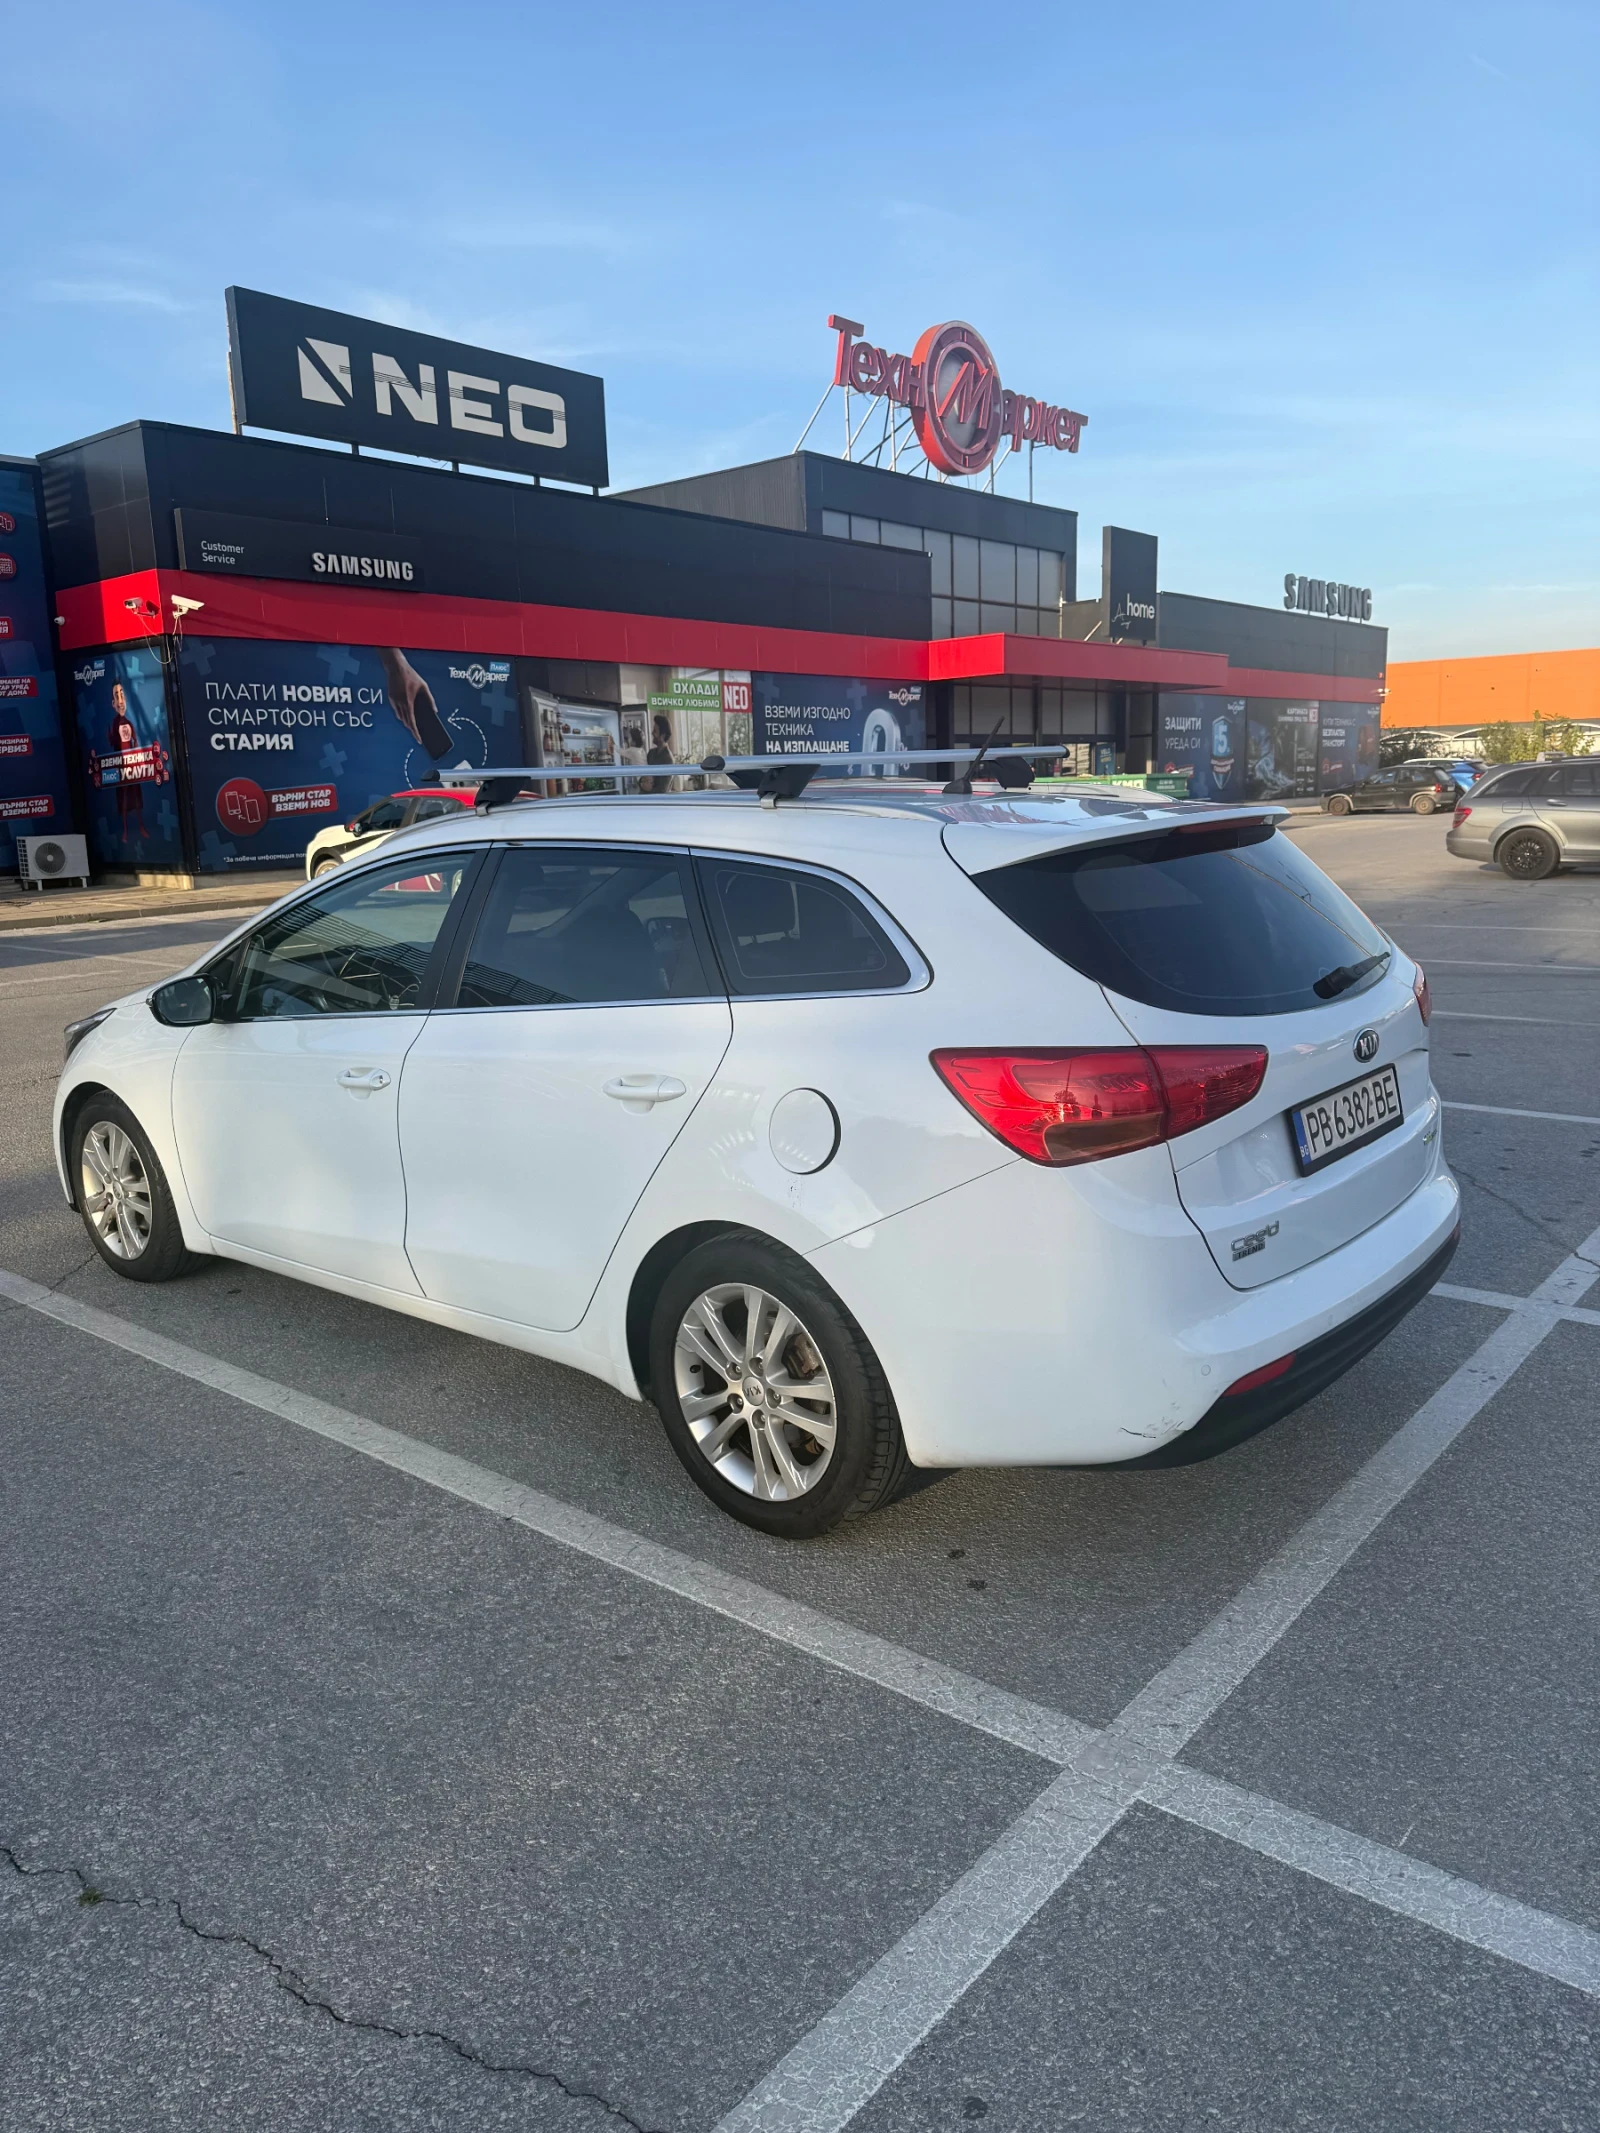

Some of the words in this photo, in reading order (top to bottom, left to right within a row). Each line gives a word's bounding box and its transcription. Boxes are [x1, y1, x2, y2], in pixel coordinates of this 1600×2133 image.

[371, 352, 567, 449] NEO
[200, 540, 244, 554] Customer
[202, 552, 236, 565] Service
[311, 552, 414, 581] SAMSUNG
[1284, 573, 1372, 621] SAMSUNG
[1126, 593, 1155, 619] home
[205, 682, 277, 700] ПЛАТИ
[283, 685, 352, 704] НОВИЯ
[357, 687, 383, 705] СИ
[673, 683, 719, 695] ОХЛАДИ
[651, 697, 683, 706] ВСИЧКО
[685, 699, 719, 708] ЛЮБИМО
[723, 685, 748, 709] NEO
[208, 706, 327, 728] СМАРТФОН
[332, 711, 373, 728] СЪС
[765, 705, 800, 718] ВЗЕМИ
[803, 706, 851, 721] ИЗГОДНО
[766, 723, 814, 736] ТЕХНИКА
[1165, 717, 1202, 731] ЗАЩИТИ
[210, 733, 294, 751] СТАРИЯ
[766, 741, 781, 753] НА
[784, 740, 849, 753] ИЗПЛАЩАНЕ
[1165, 737, 1189, 750] УРЕДА
[1190, 738, 1201, 748] СИ
[100, 755, 122, 768] ВЗЕМИ
[123, 751, 153, 765] ТЕХНИКА
[120, 764, 154, 780] УСЛУГИ
[28, 799, 49, 807] СТАР
[272, 790, 305, 803] ВЪРНИ
[307, 788, 331, 801] СТАР
[2, 808, 30, 817] ВЗЕМИ
[31, 806, 48, 814] НОВ
[275, 800, 309, 812] ВЗЕМИ
[312, 798, 331, 809] НОВ
[257, 853, 294, 861] информация
[1360, 1034, 1378, 1057] KIA
